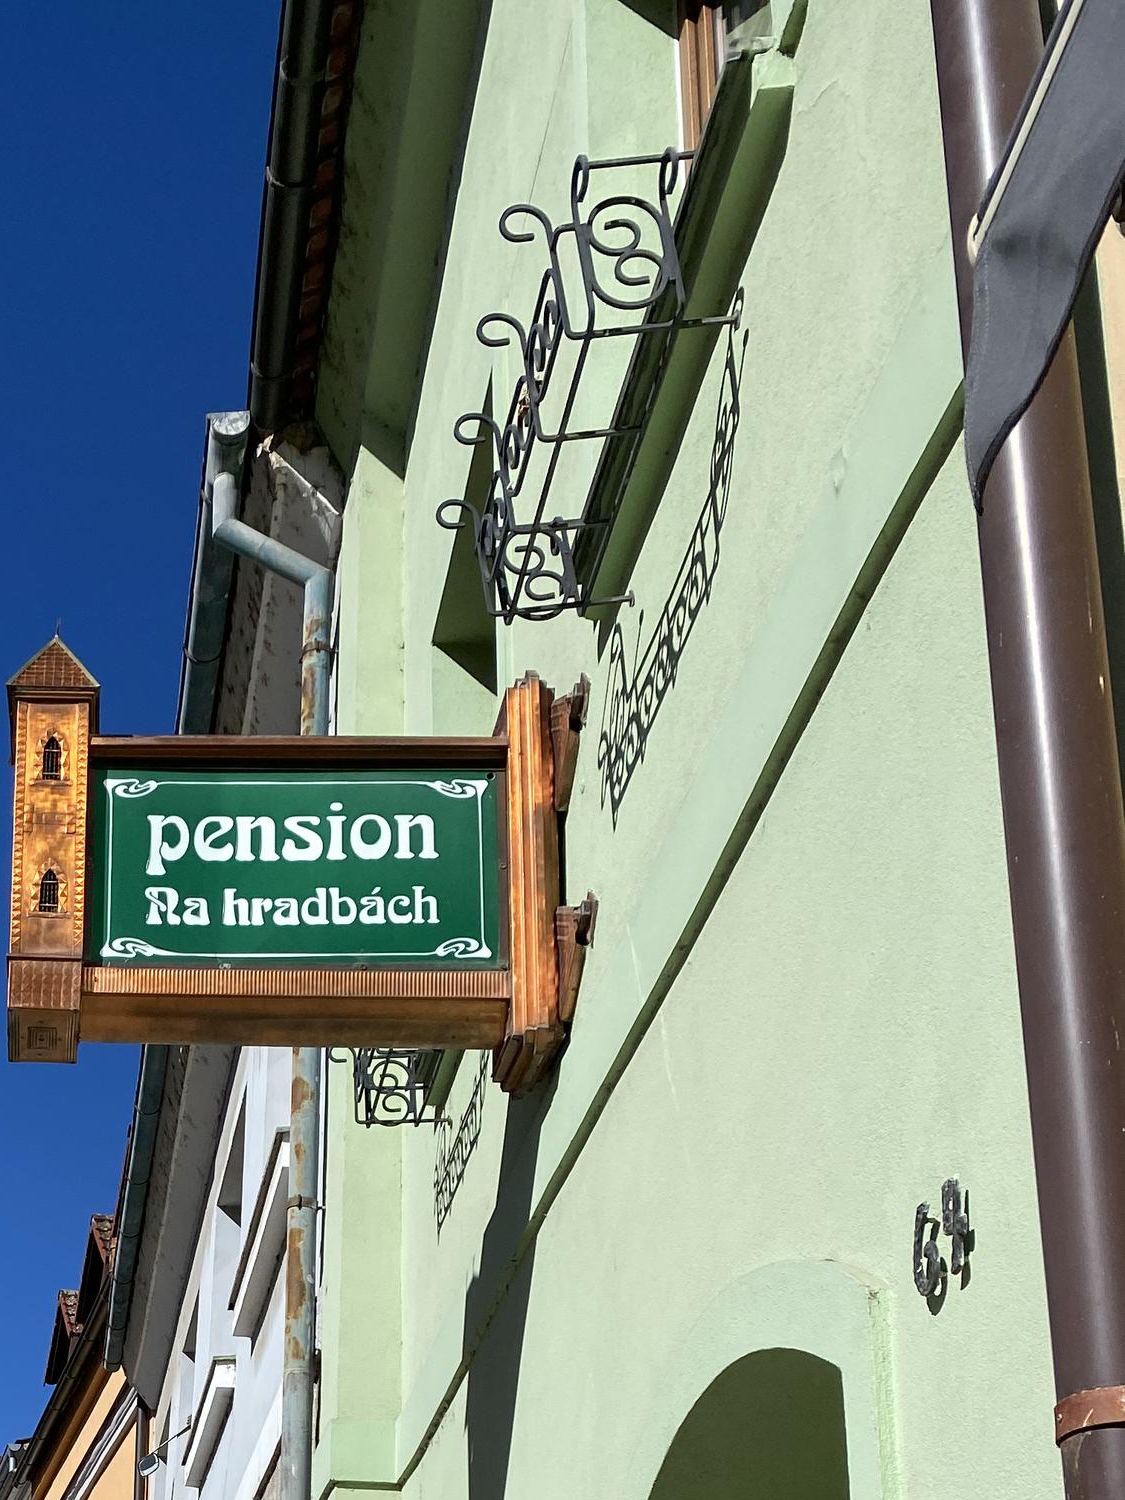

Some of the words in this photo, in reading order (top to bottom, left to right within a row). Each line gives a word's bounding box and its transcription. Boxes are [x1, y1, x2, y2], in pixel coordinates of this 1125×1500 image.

[146, 802, 439, 875] pension
[145, 887, 210, 926] Na
[222, 886, 440, 926] hradbách
[913, 1177, 968, 1297] 64
